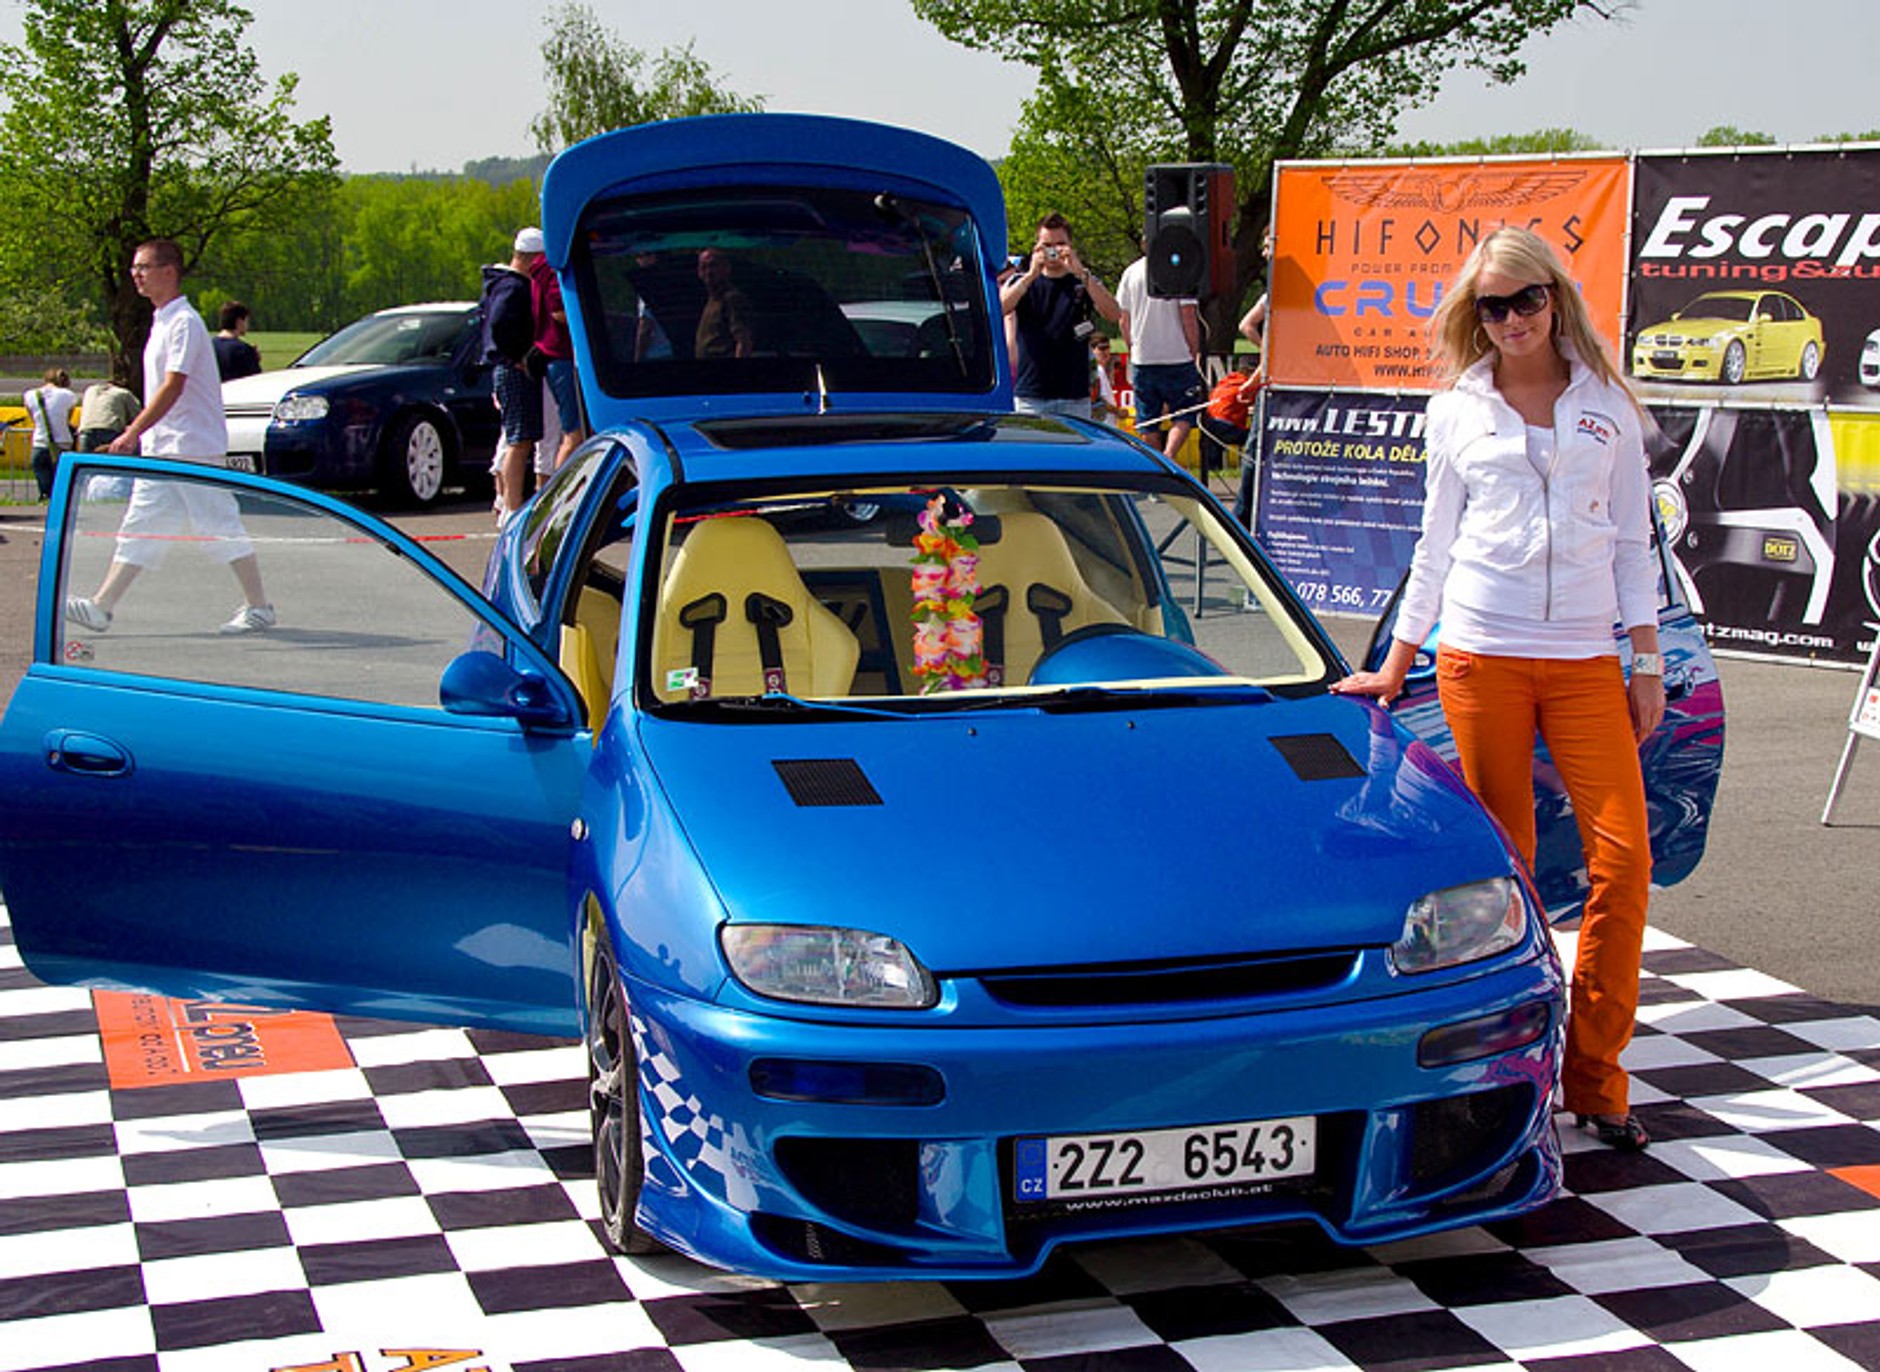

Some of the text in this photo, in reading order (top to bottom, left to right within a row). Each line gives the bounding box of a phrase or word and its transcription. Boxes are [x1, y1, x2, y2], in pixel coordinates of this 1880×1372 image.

[1316, 214, 1585, 255] HIFONS
[1639, 196, 1880, 268] Escap
[1351, 263, 1402, 273] POWER
[1410, 263, 1452, 273] FROM
[1316, 345, 1350, 357] AUTO
[1354, 345, 1380, 358] HIFI
[1274, 440, 1341, 457] PROTOŽE
[1344, 444, 1386, 460] KOLA
[1371, 589, 1393, 607] 77
[1184, 1125, 1295, 1180] 6543
[1021, 1178, 1043, 1193] CZ
[1065, 1183, 1273, 1211] www.mazdaclub.at
